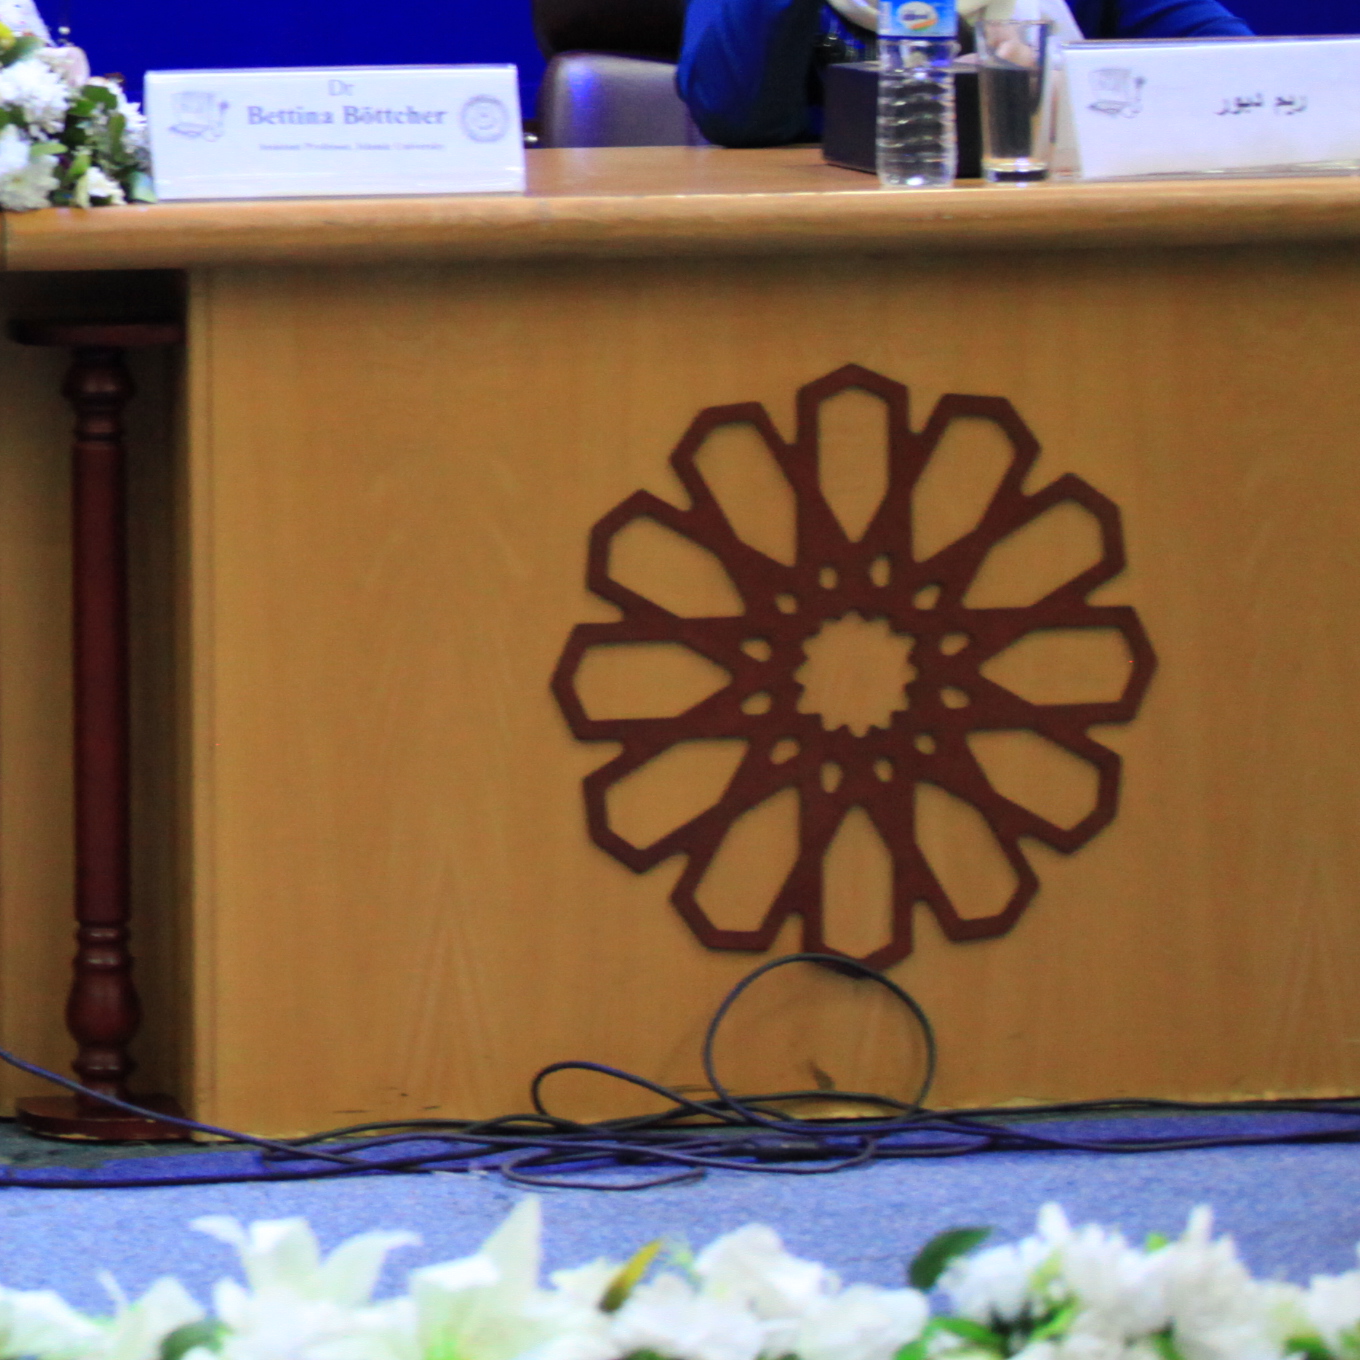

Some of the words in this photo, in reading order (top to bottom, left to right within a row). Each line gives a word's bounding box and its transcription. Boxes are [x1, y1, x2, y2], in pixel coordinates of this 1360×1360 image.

[327, 78, 354, 97] Dr
[246, 105, 334, 125] Bettina
[343, 104, 448, 125] Böttcher
